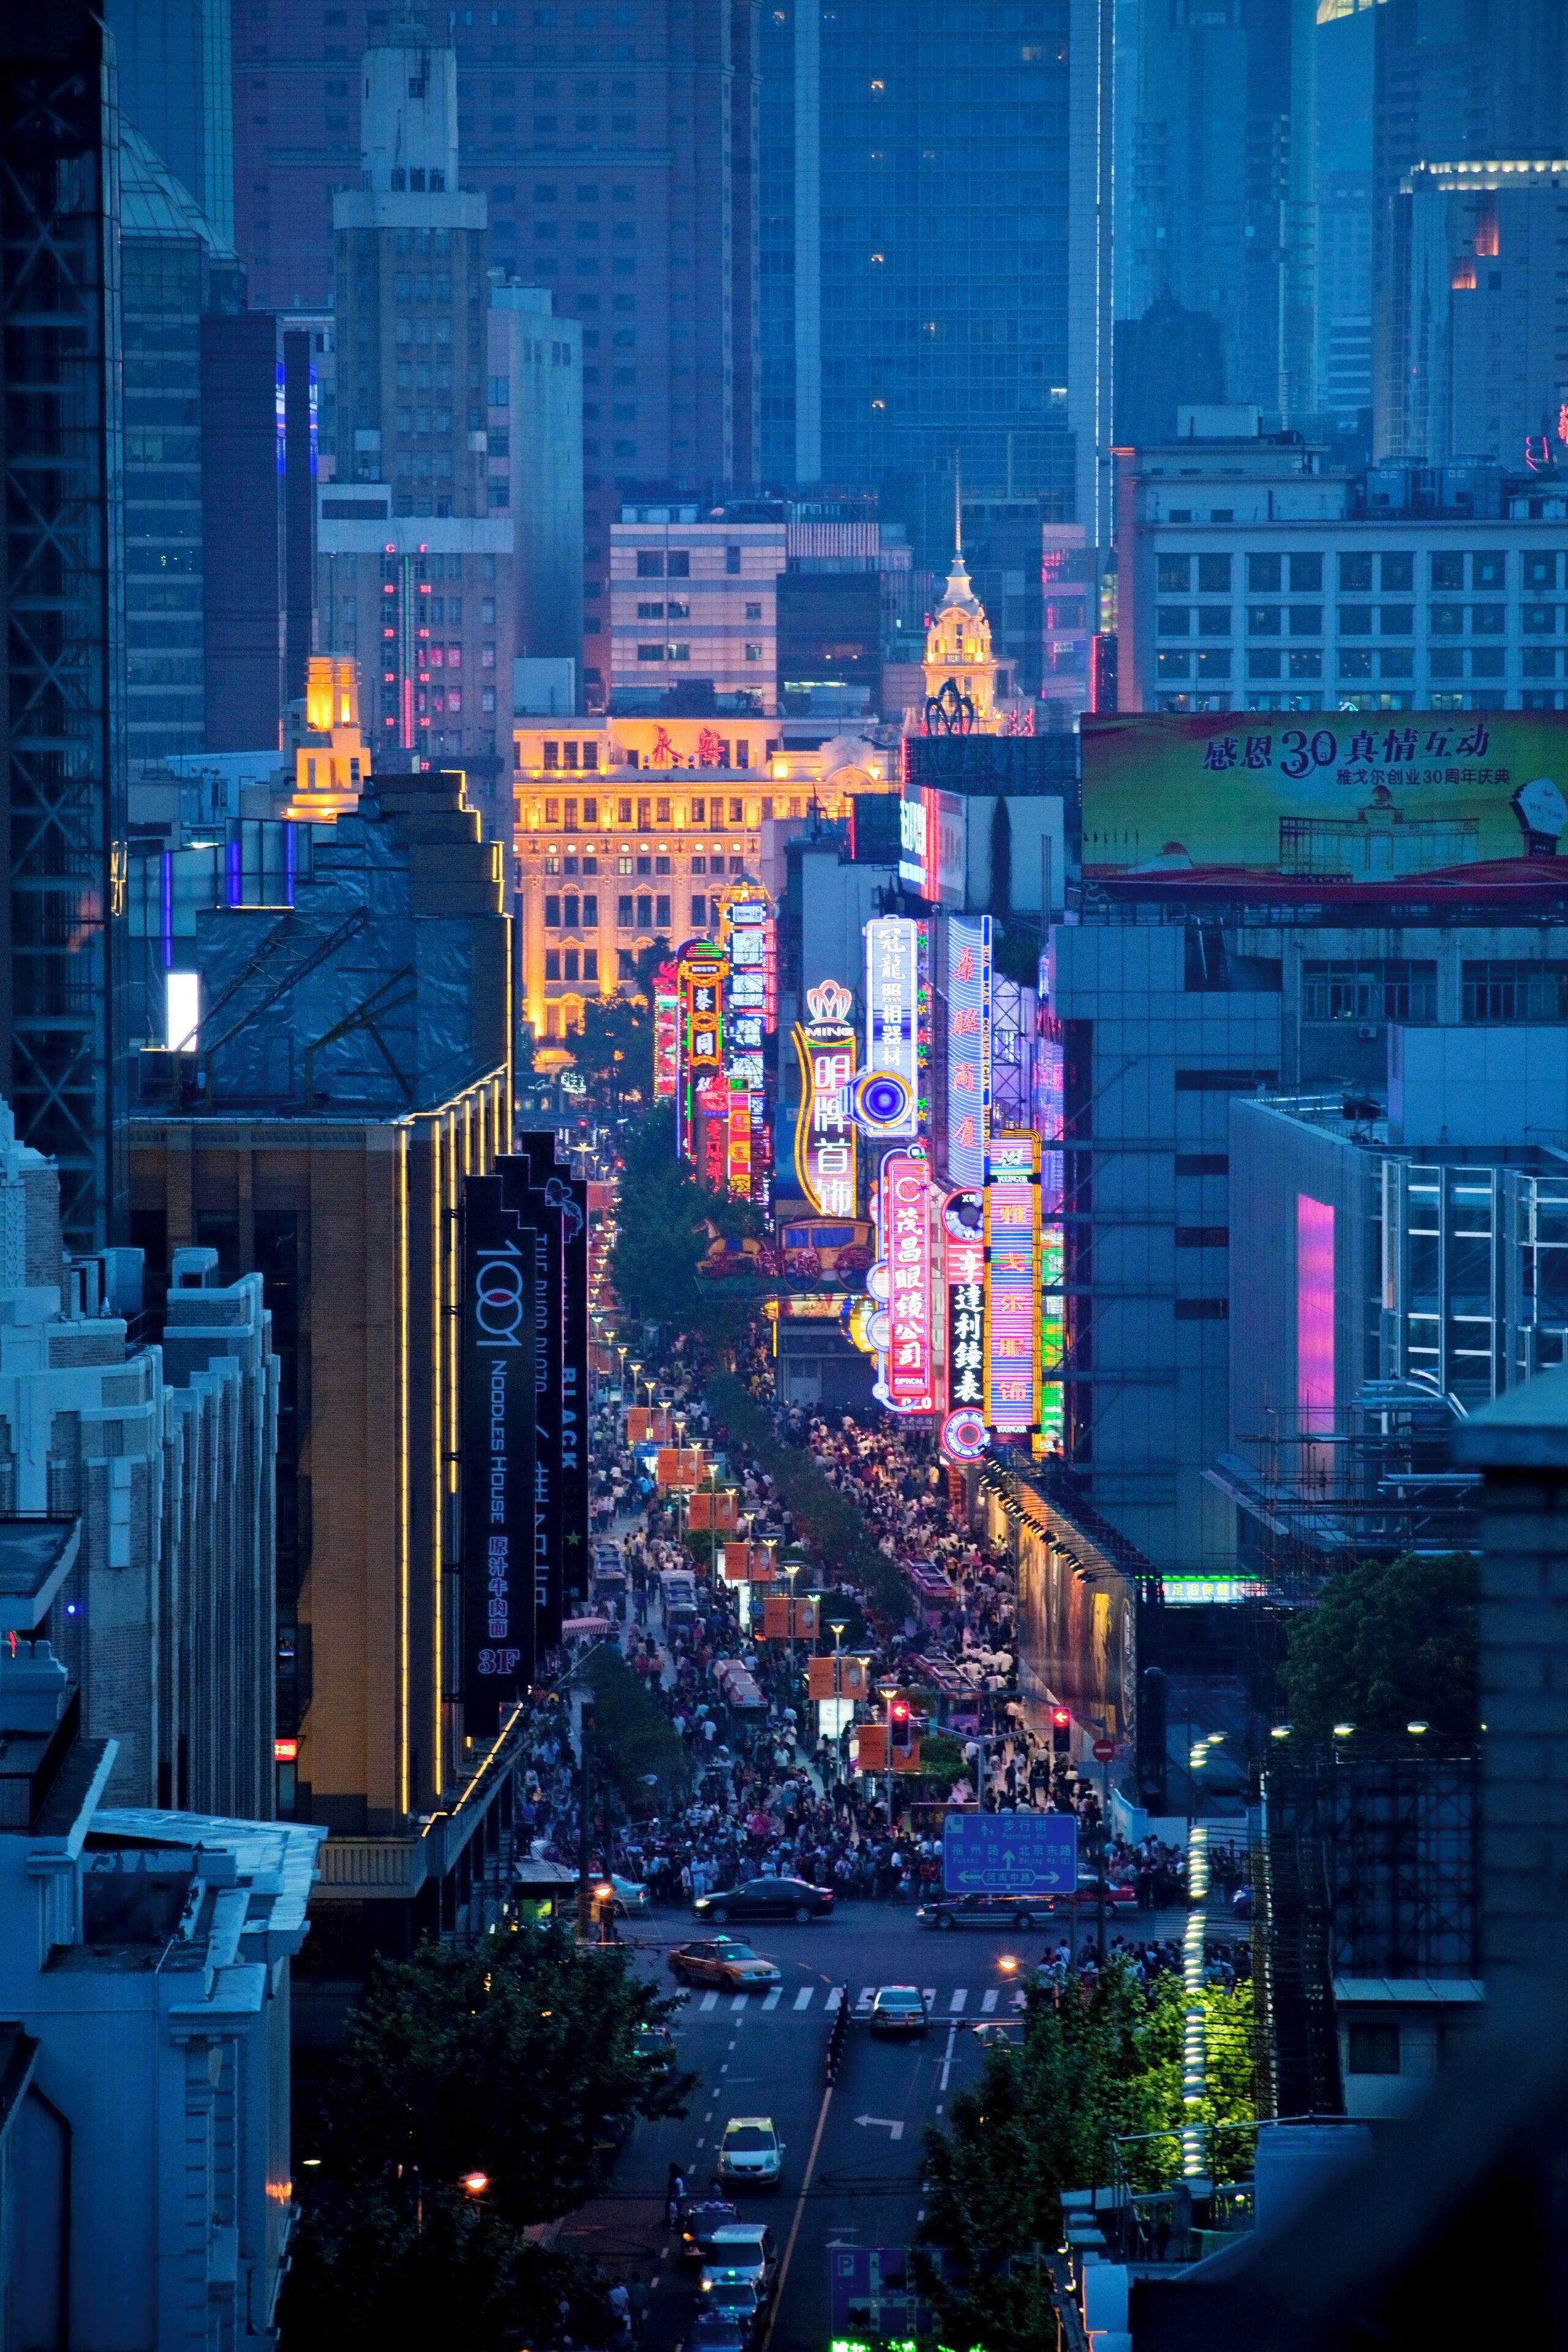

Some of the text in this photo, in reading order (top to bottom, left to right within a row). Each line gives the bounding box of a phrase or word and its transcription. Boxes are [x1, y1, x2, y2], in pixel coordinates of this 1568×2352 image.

[652, 726, 725, 762] 永安
[1336, 767, 1510, 786] 雅戈尔创业30周年庆典
[877, 927, 907, 1066] 冠龍照相器材
[804, 1026, 854, 1037] MING
[814, 1055, 852, 1218] 明牌首饰
[997, 1175, 1028, 1184] YOUNGOR
[998, 1204, 1027, 1400] 雅戈尔服饰
[996, 1425, 1027, 1433] YOUNGOR
[491, 1360, 507, 1523] NOODLES HOUSE
[488, 1536, 508, 1638] 原汁牛肉面
[478, 1649, 520, 1674] 3F
[1003, 1820, 1047, 1832] 步行街
[952, 1844, 999, 1856] 福州路
[1019, 1844, 1071, 1856] 北京东路
[987, 1872, 1031, 1882] 河南中路
